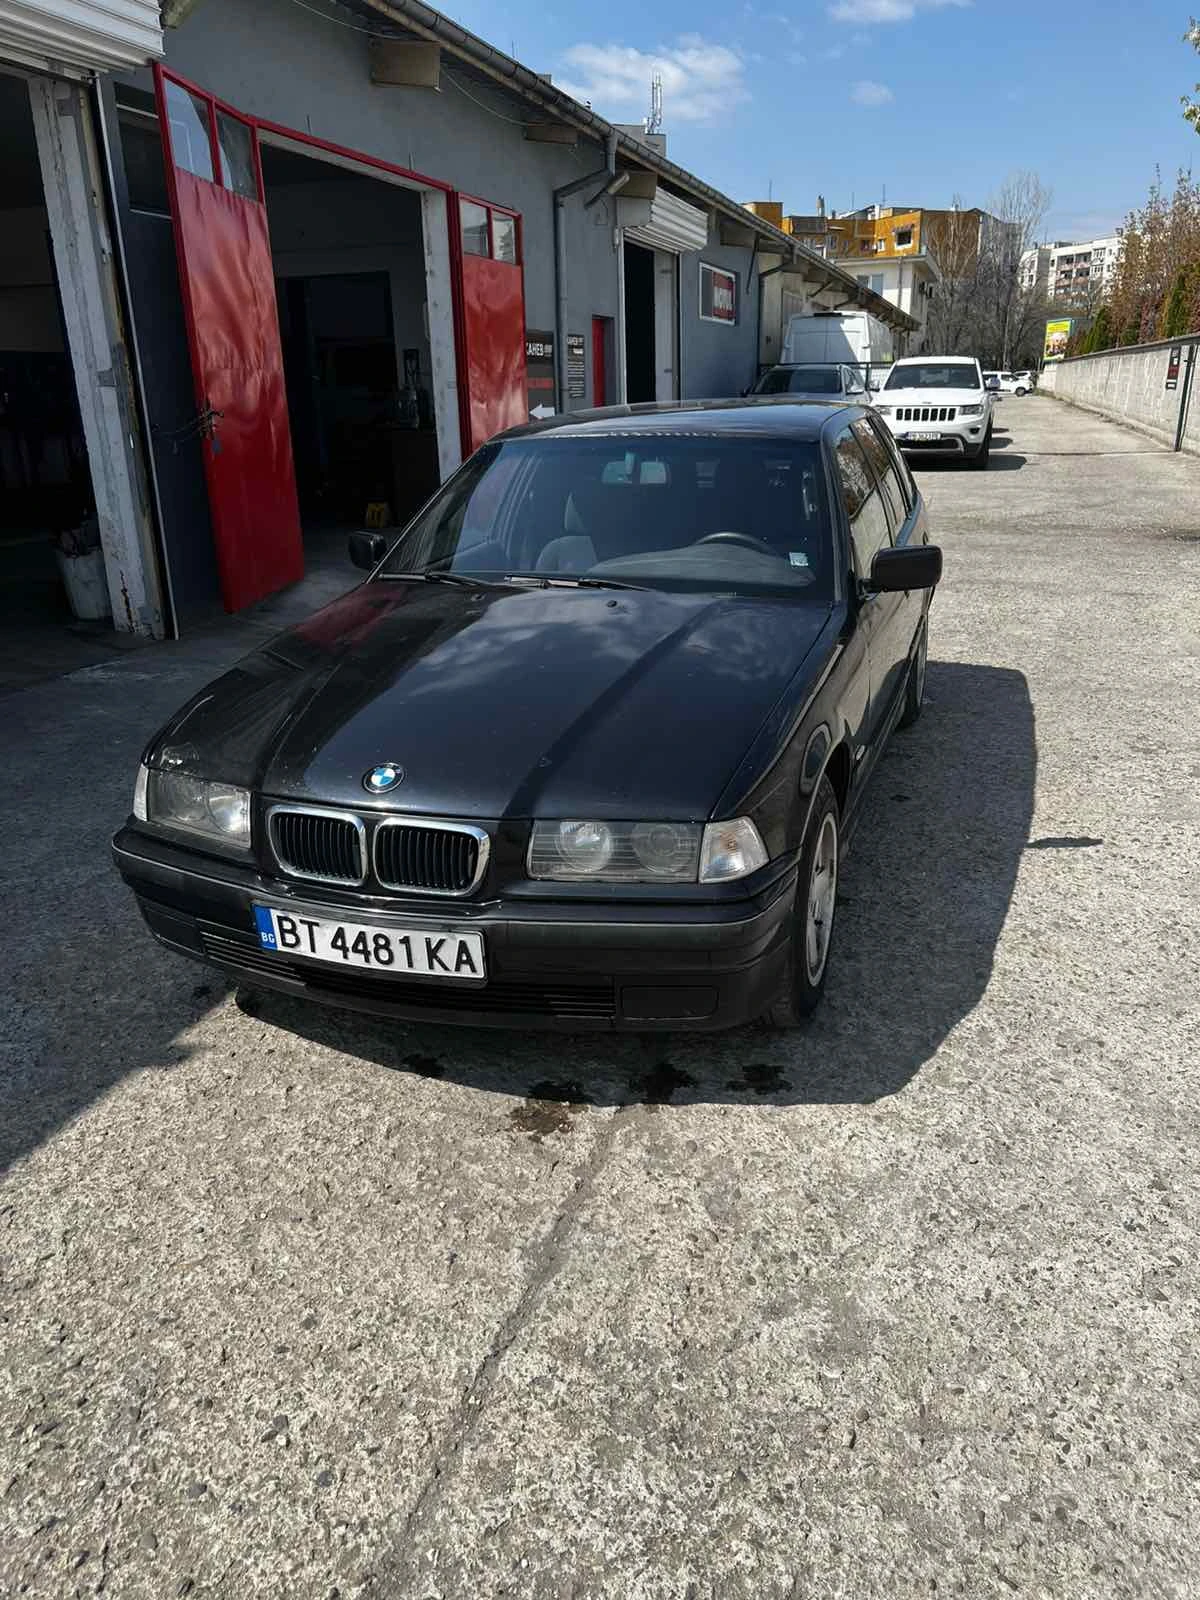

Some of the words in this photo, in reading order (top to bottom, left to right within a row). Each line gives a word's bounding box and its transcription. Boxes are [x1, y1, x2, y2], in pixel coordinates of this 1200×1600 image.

[261, 931, 275, 944] BG
[276, 914, 320, 954] BT
[330, 926, 414, 969] 4481
[424, 936, 478, 974] KA
